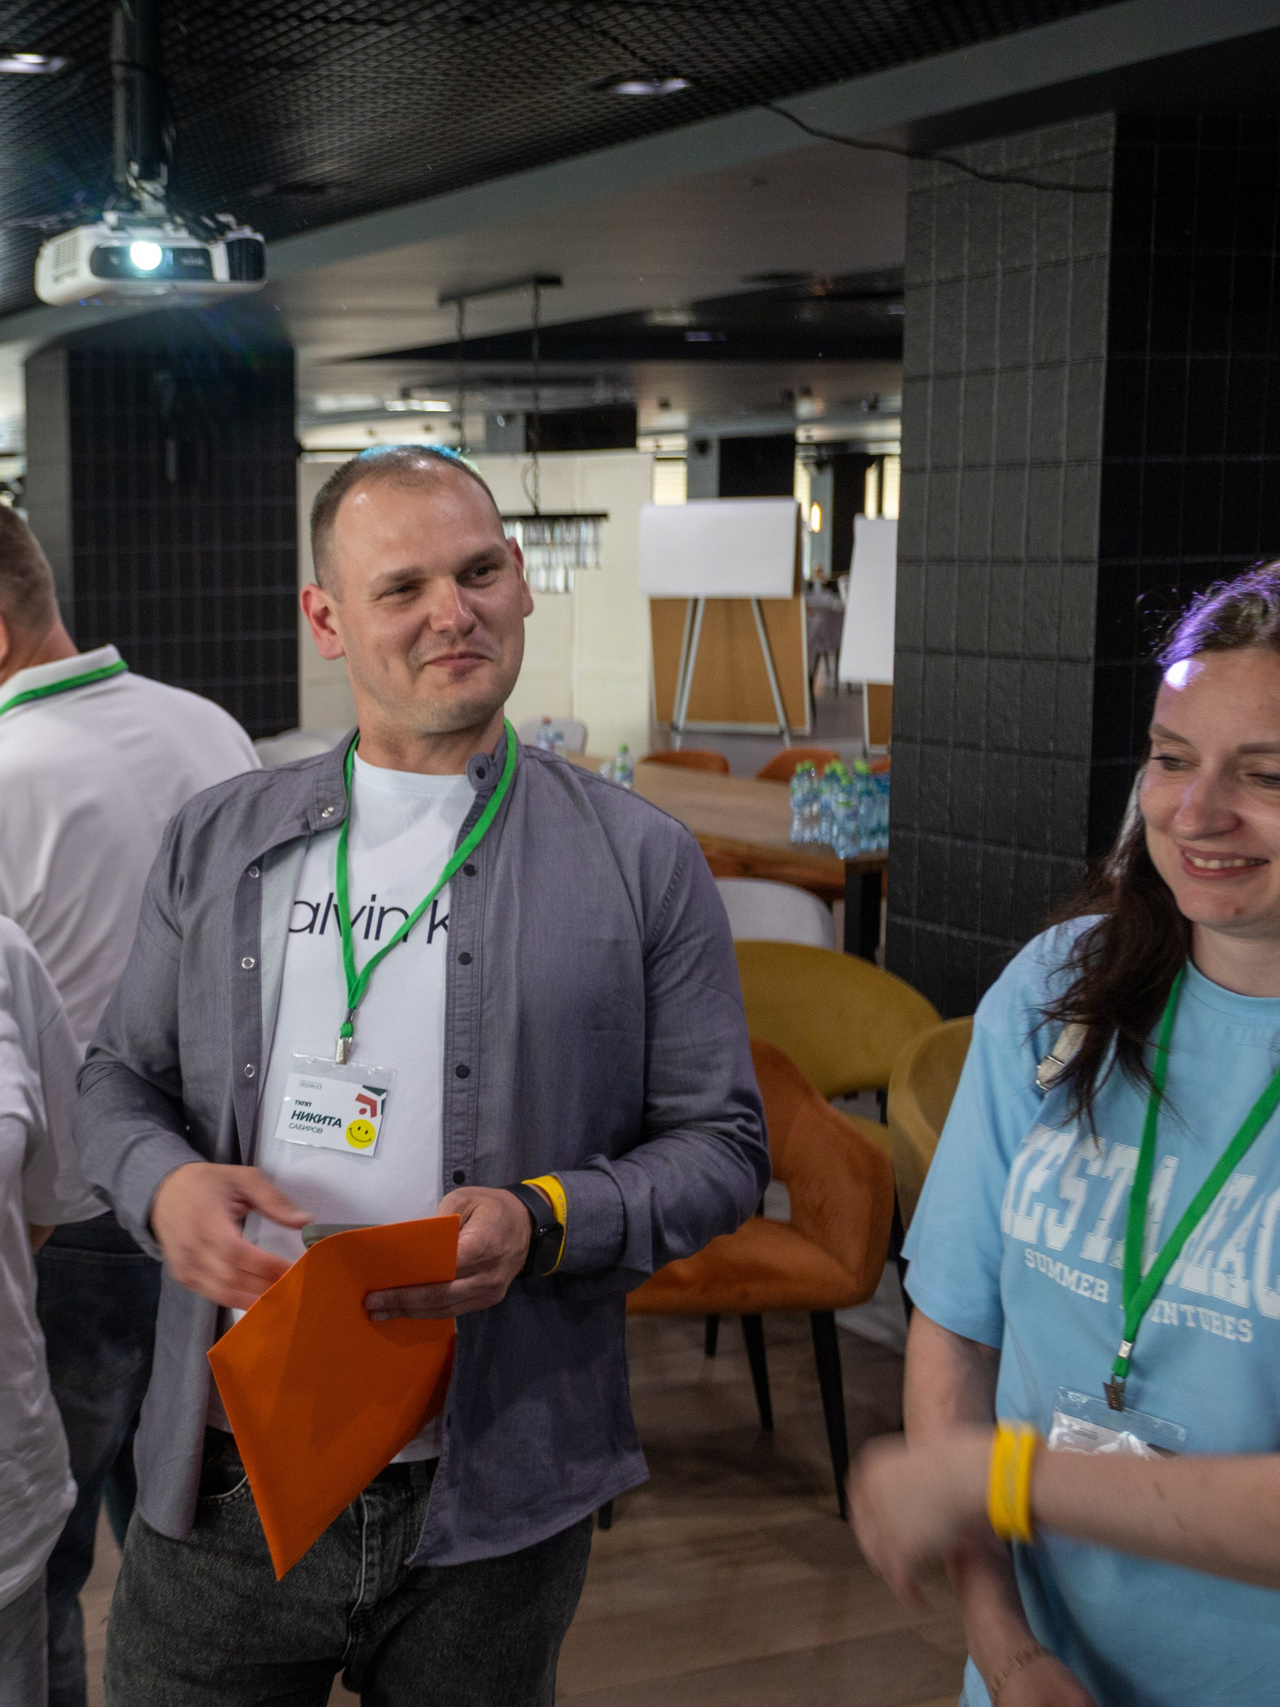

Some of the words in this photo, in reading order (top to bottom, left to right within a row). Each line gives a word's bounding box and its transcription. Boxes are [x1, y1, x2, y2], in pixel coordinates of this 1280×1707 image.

[289, 1122, 324, 1134] САБИРОВ
[291, 1110, 342, 1128] НИКИТА
[1024, 1247, 1110, 1303] SUMMER
